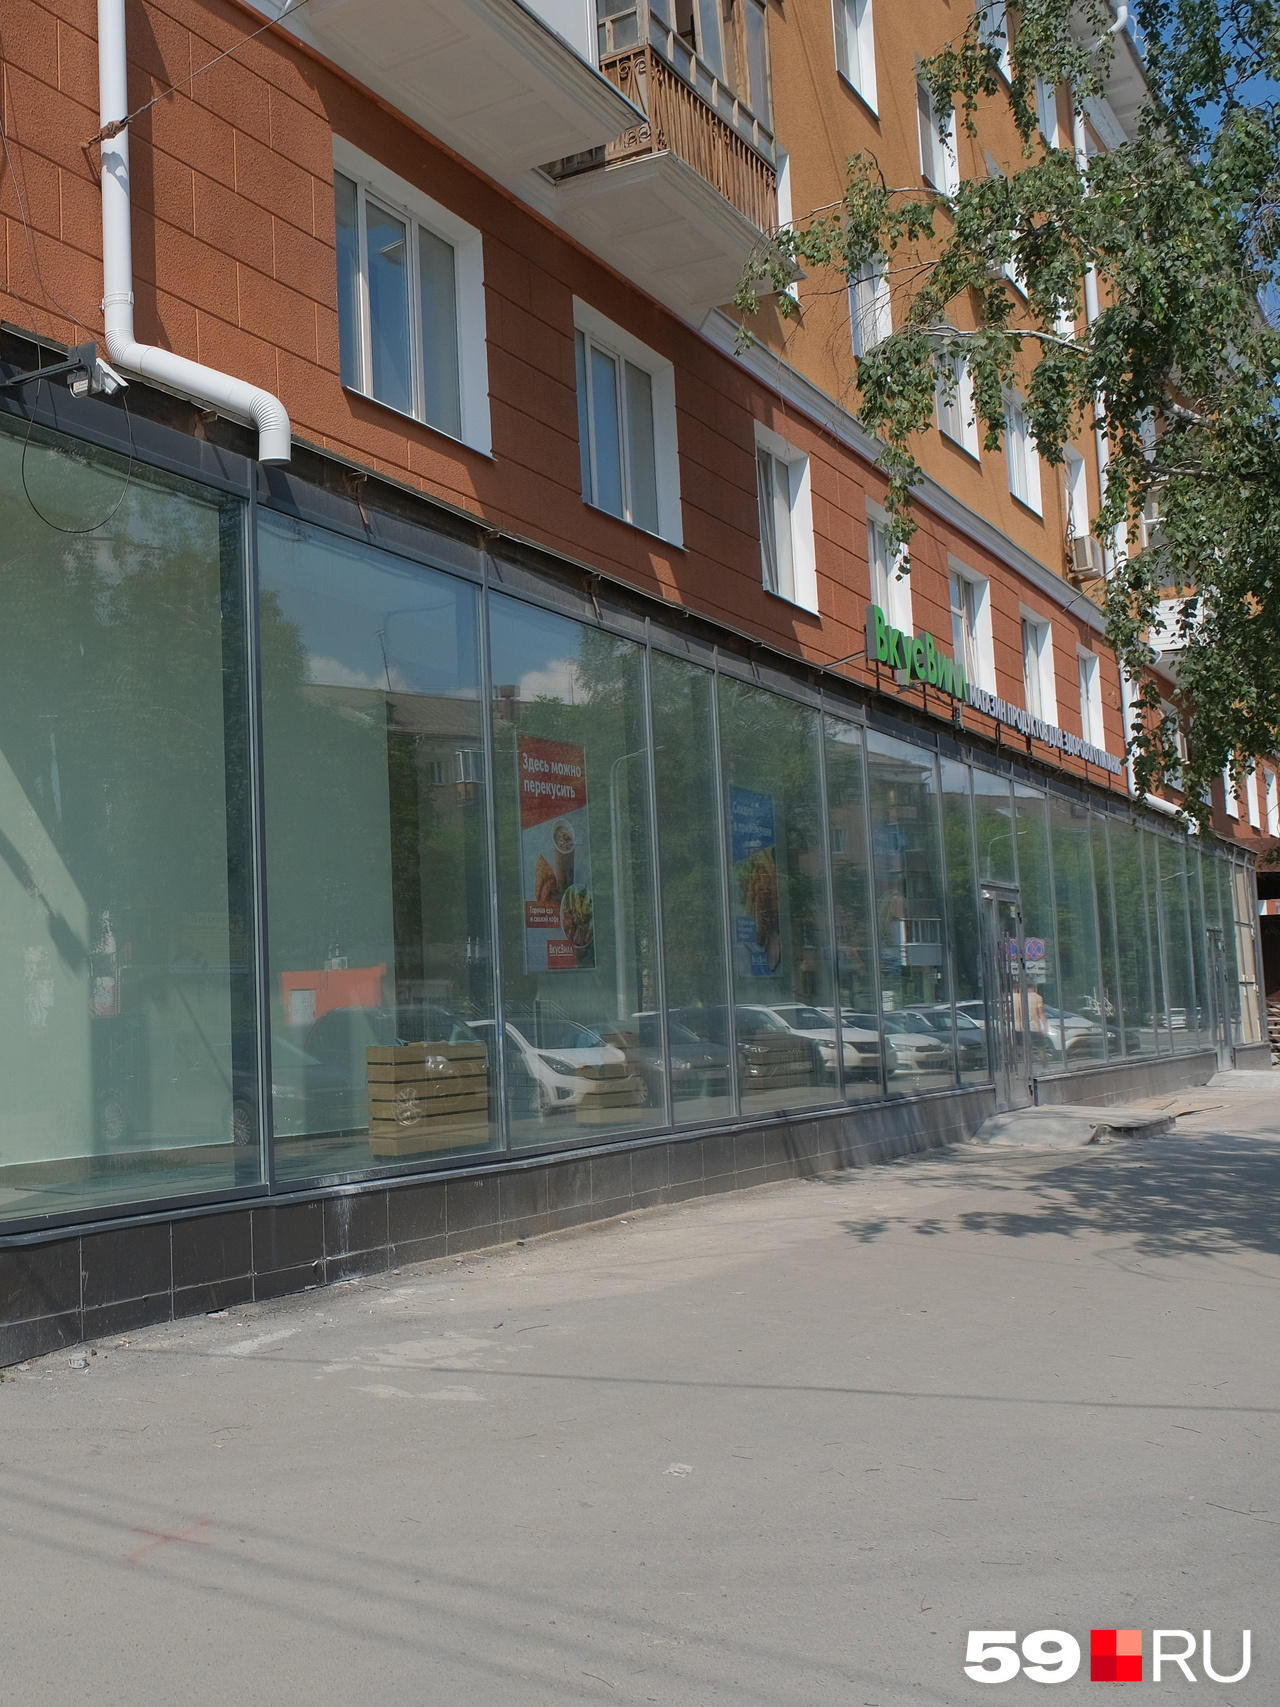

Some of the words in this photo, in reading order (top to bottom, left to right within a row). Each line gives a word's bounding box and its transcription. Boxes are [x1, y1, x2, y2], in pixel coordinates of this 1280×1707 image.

[869, 604, 969, 703] ВкусВилл
[970, 684, 1007, 723] МАГАЗИН
[1007, 703, 1049, 742] ПРОДУКТОВ
[1049, 725, 1063, 749] ДЛЯ
[1063, 731, 1098, 764] ЗДОРОВОГО
[522, 752, 550, 773] Здесь
[550, 761, 582, 778] можно
[523, 780, 576, 799] перекусить
